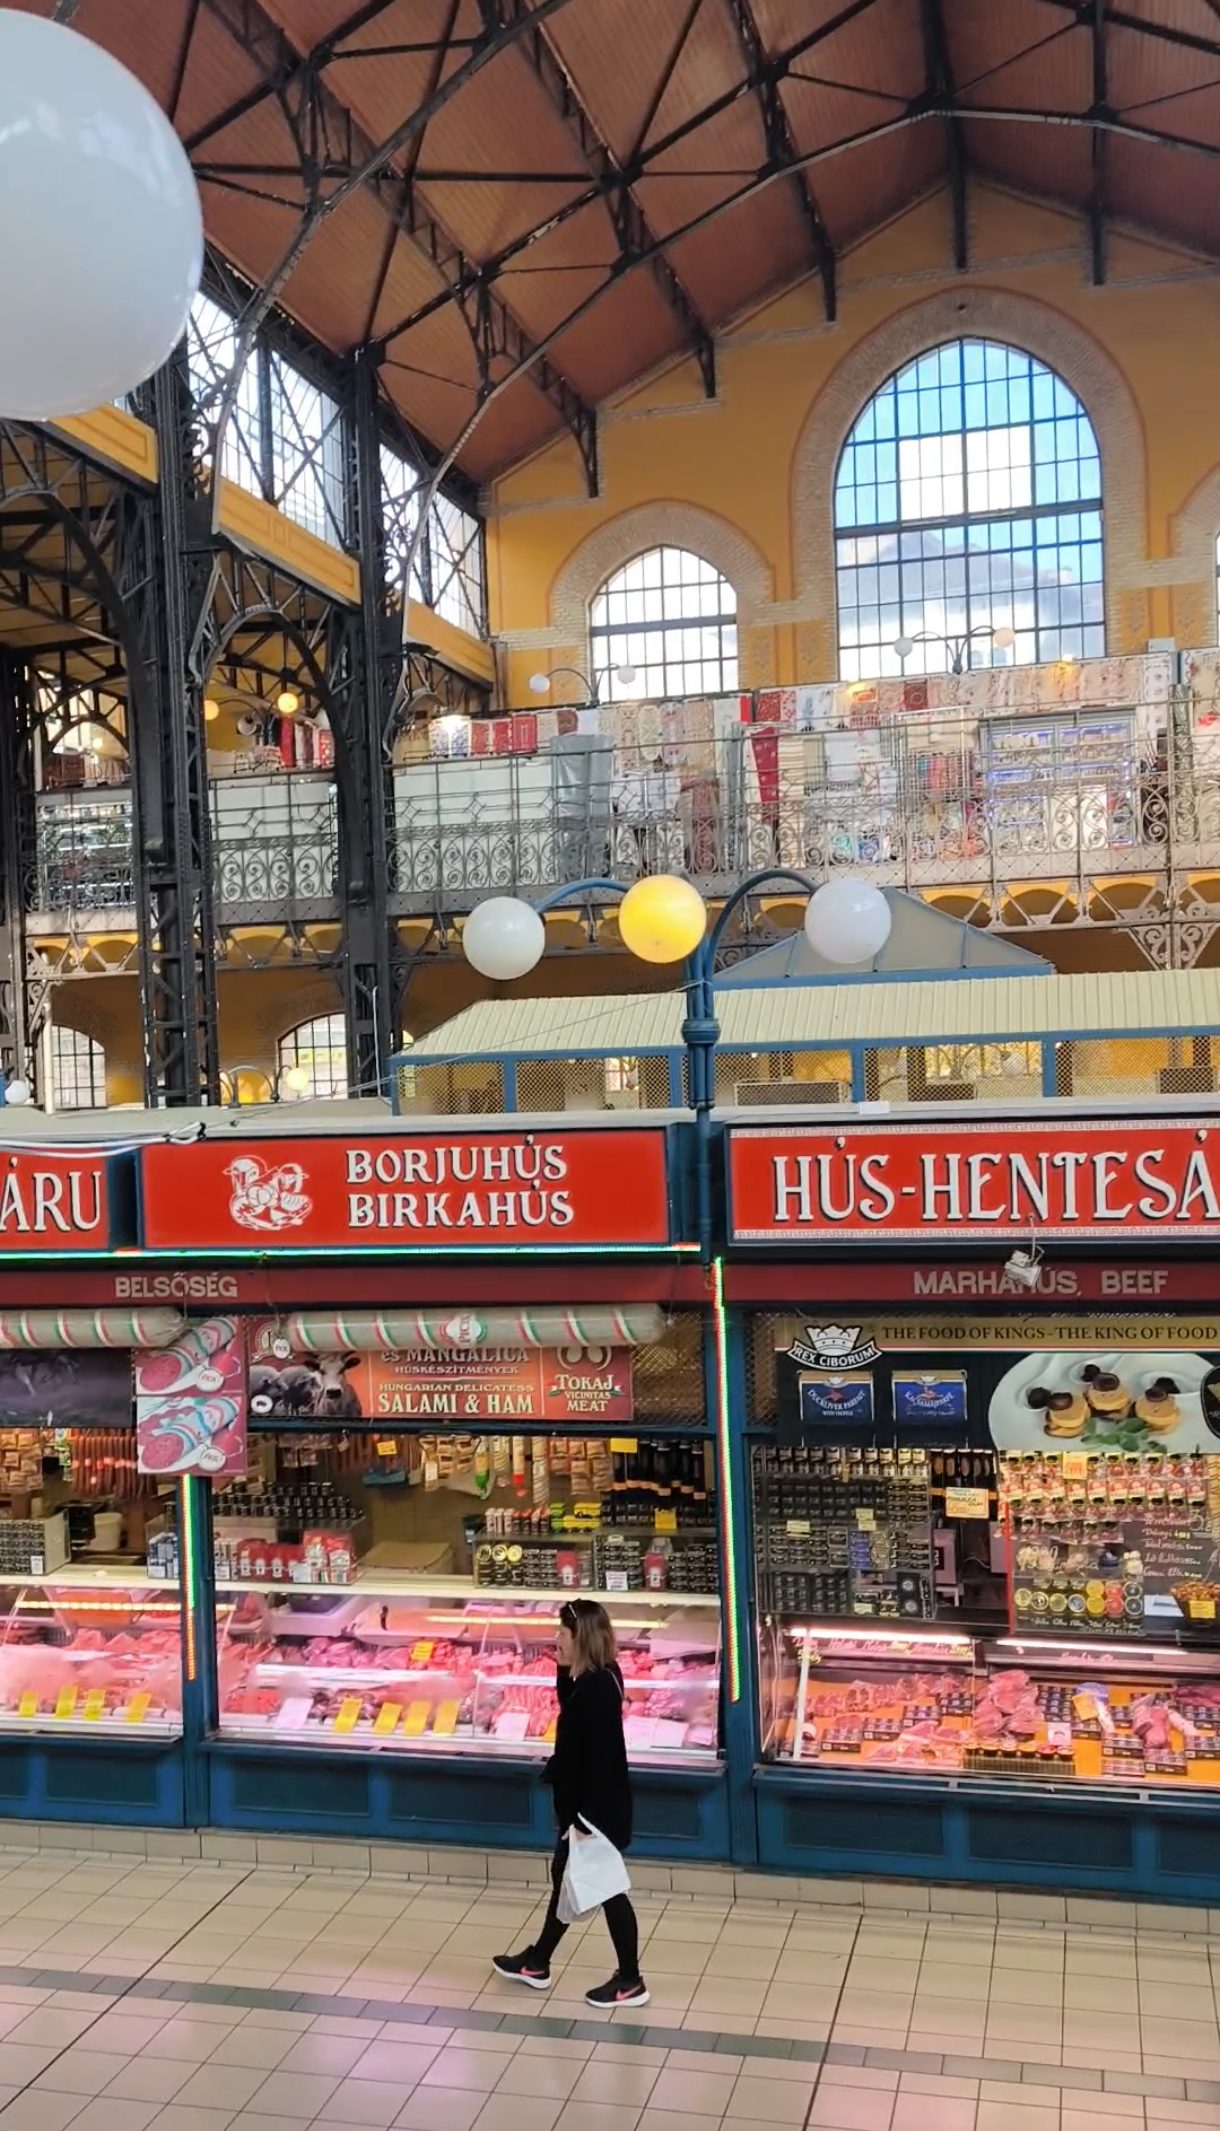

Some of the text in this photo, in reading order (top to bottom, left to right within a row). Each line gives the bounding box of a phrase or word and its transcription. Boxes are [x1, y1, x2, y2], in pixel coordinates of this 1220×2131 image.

[346, 1134, 569, 1185] BORJUHÚS
[0, 1157, 102, 1232] ÁRU
[348, 1181, 575, 1228] BIRKAHÚS
[115, 1271, 238, 1298] BELSŐSÉG
[1101, 1270, 1169, 1294] BEEF
[881, 1326, 916, 1339] THE
[919, 1326, 966, 1339] FOOD
[969, 1326, 991, 1339] OF
[994, 1326, 1045, 1339] KINGS
[1055, 1326, 1091, 1339] THE
[1095, 1326, 1137, 1339] KING
[1140, 1326, 1164, 1339] OF
[1167, 1326, 1218, 1339] FOOD
[794, 1347, 874, 1367] REX CIBORUM
[379, 1383, 534, 1392] HUNGARIAN DELICATESS
[555, 1374, 614, 1390] TOKAJ
[378, 1392, 533, 1414] SALAMI & HAM
[565, 1391, 611, 1399] VICINITAS
[567, 1400, 608, 1411] MEAT
